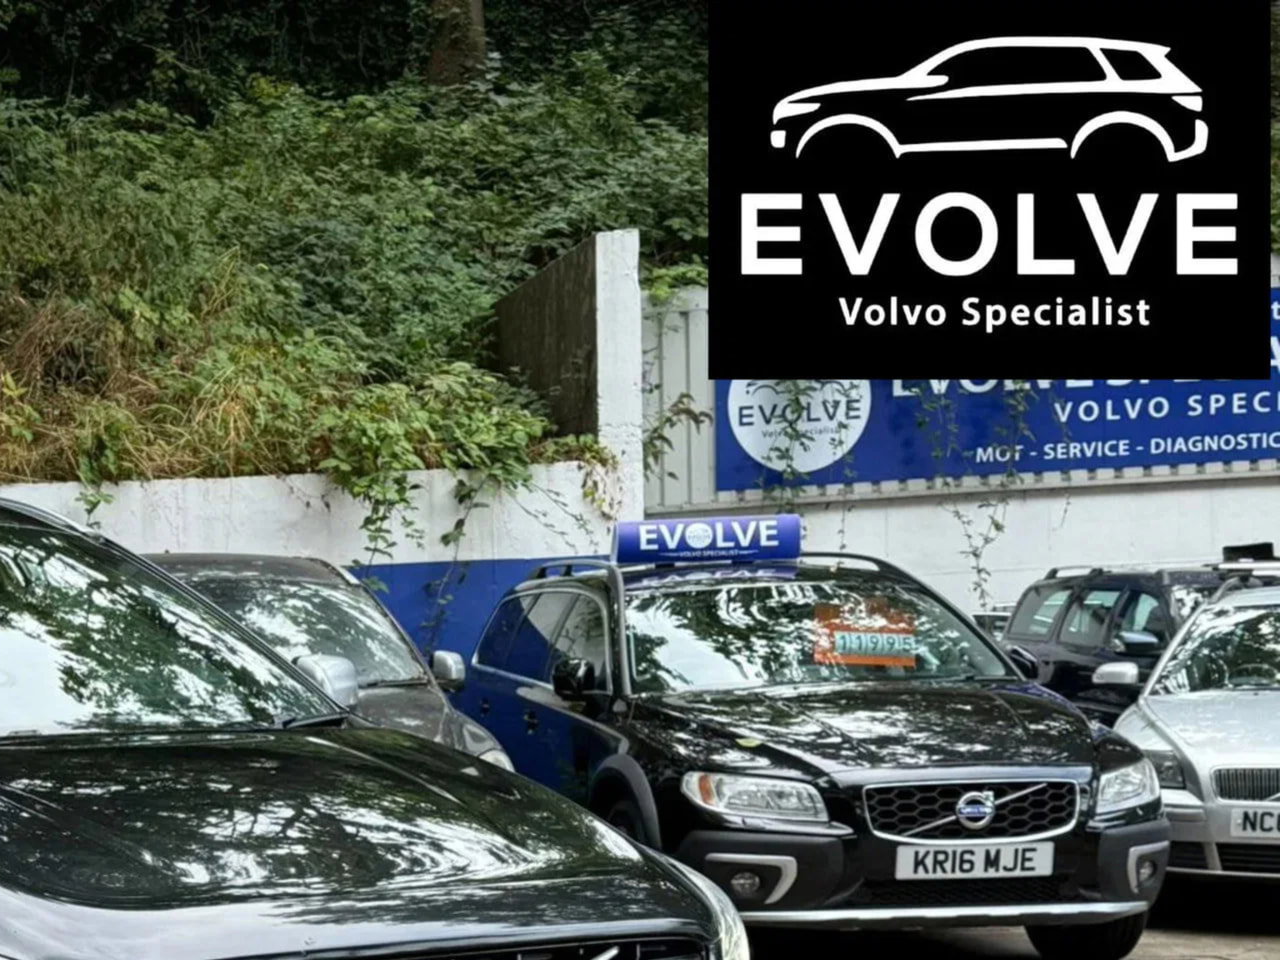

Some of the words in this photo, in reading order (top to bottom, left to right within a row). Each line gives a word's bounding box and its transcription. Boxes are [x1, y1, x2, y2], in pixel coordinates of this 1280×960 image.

[738, 399, 861, 427] EVOLVE
[1053, 396, 1170, 423] VOLVO
[975, 445, 1024, 464] MOT
[1043, 439, 1131, 460] SERVICE
[638, 519, 780, 550] EVOLVE
[839, 635, 914, 652] 11995
[1242, 811, 1280, 832] NC
[913, 850, 976, 875] KR16
[983, 848, 1038, 872] MJE
